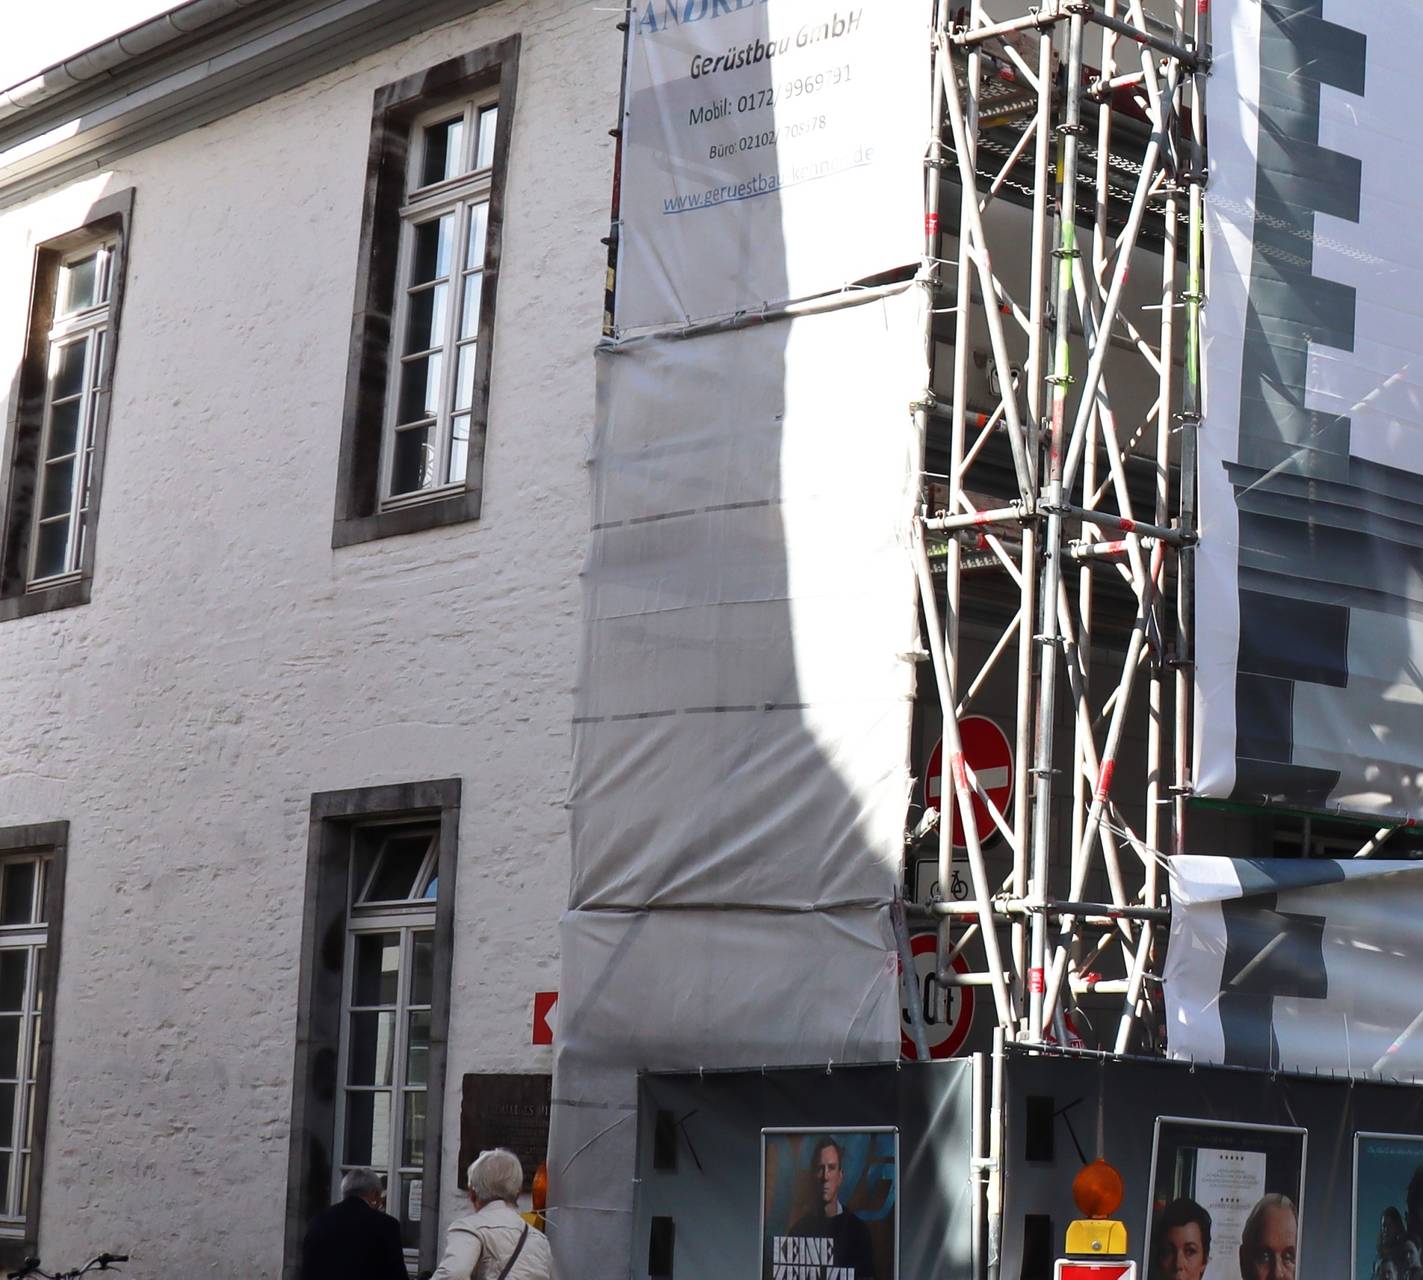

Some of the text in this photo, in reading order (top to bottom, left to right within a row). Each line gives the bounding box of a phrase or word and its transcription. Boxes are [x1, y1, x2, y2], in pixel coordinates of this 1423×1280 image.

[690, 8, 863, 79] Gerüstbau GmbH
[689, 97, 732, 126] Mobil:
[709, 142, 737, 159] Büro:
[773, 1235, 834, 1265] KEINE
